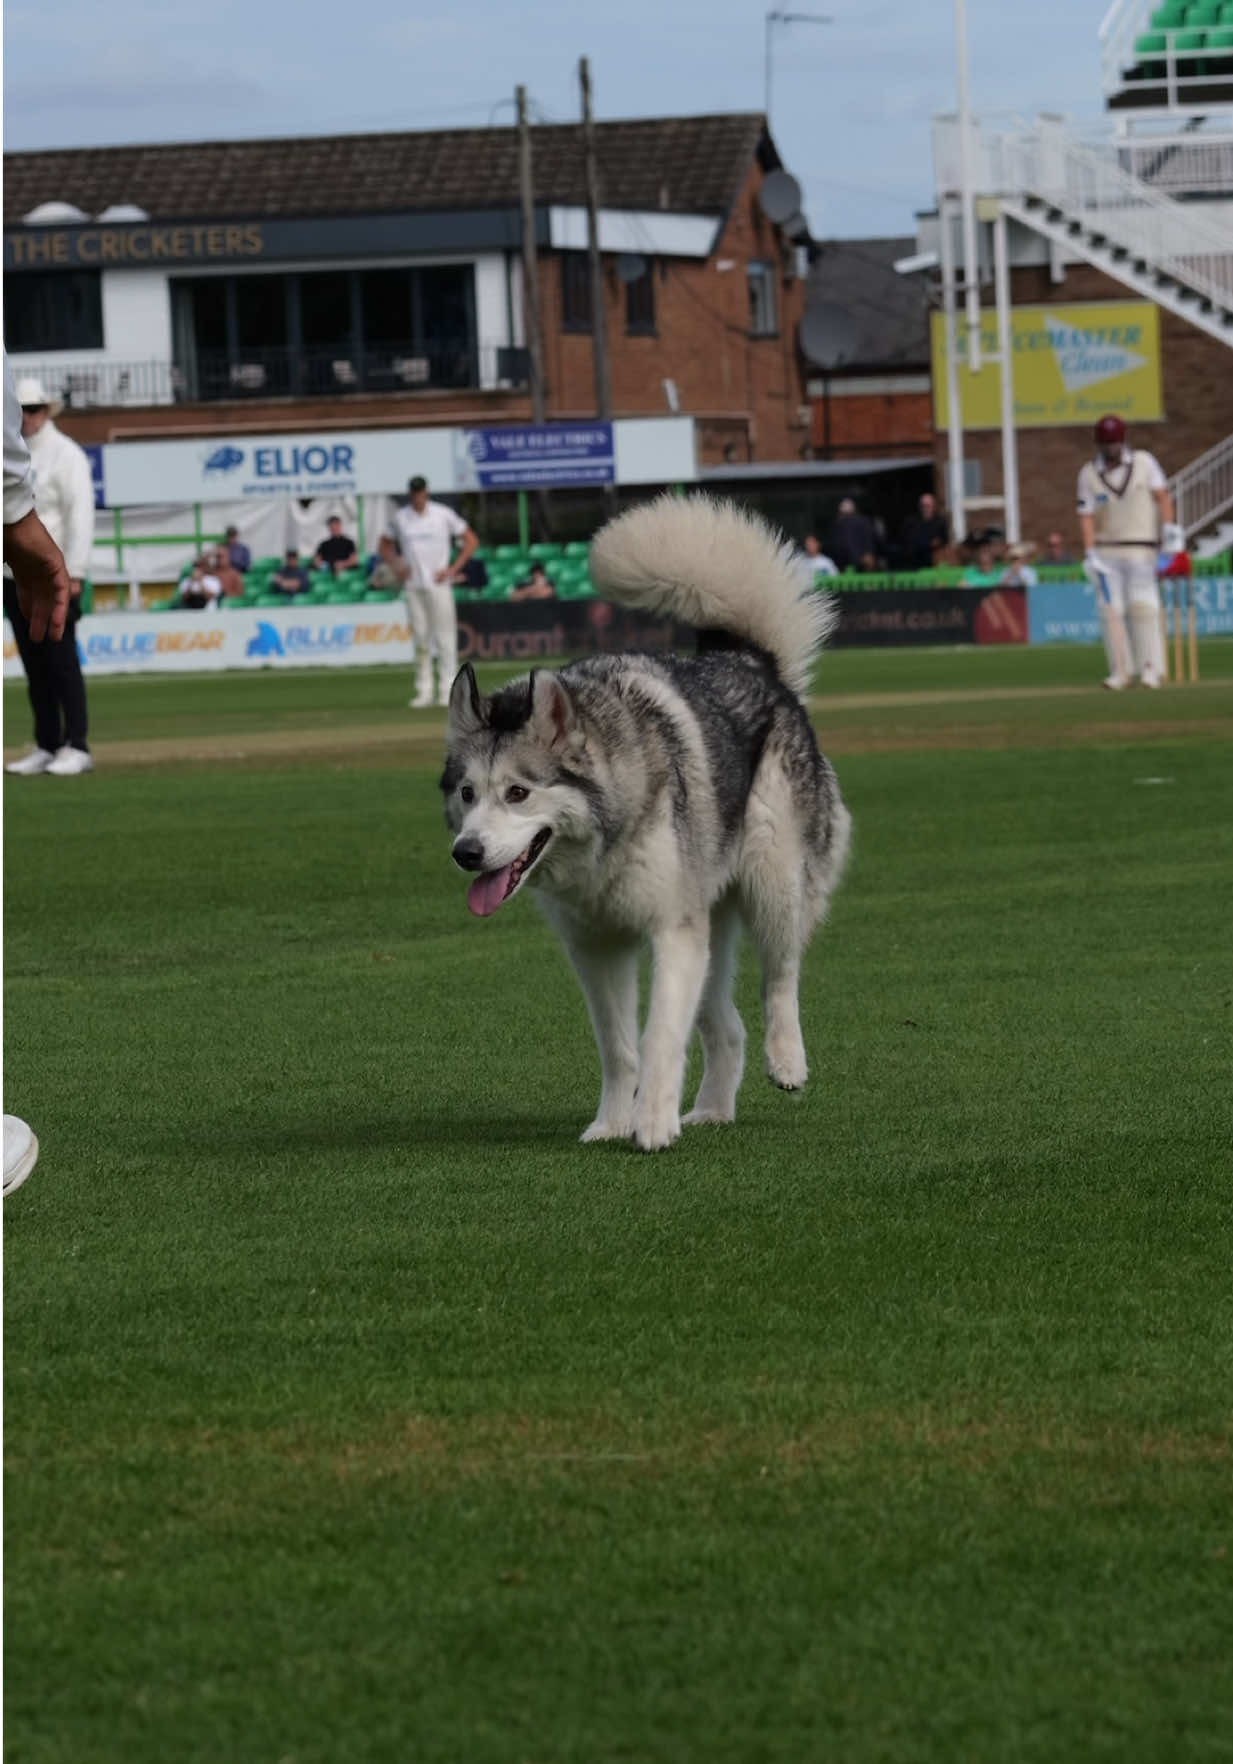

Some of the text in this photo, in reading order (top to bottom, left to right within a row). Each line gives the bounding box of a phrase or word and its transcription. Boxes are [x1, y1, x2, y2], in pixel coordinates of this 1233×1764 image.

[9, 225, 263, 263] THE CRICKETERS
[254, 445, 354, 477] ELIOR
[88, 629, 226, 656] BLUEBEAR
